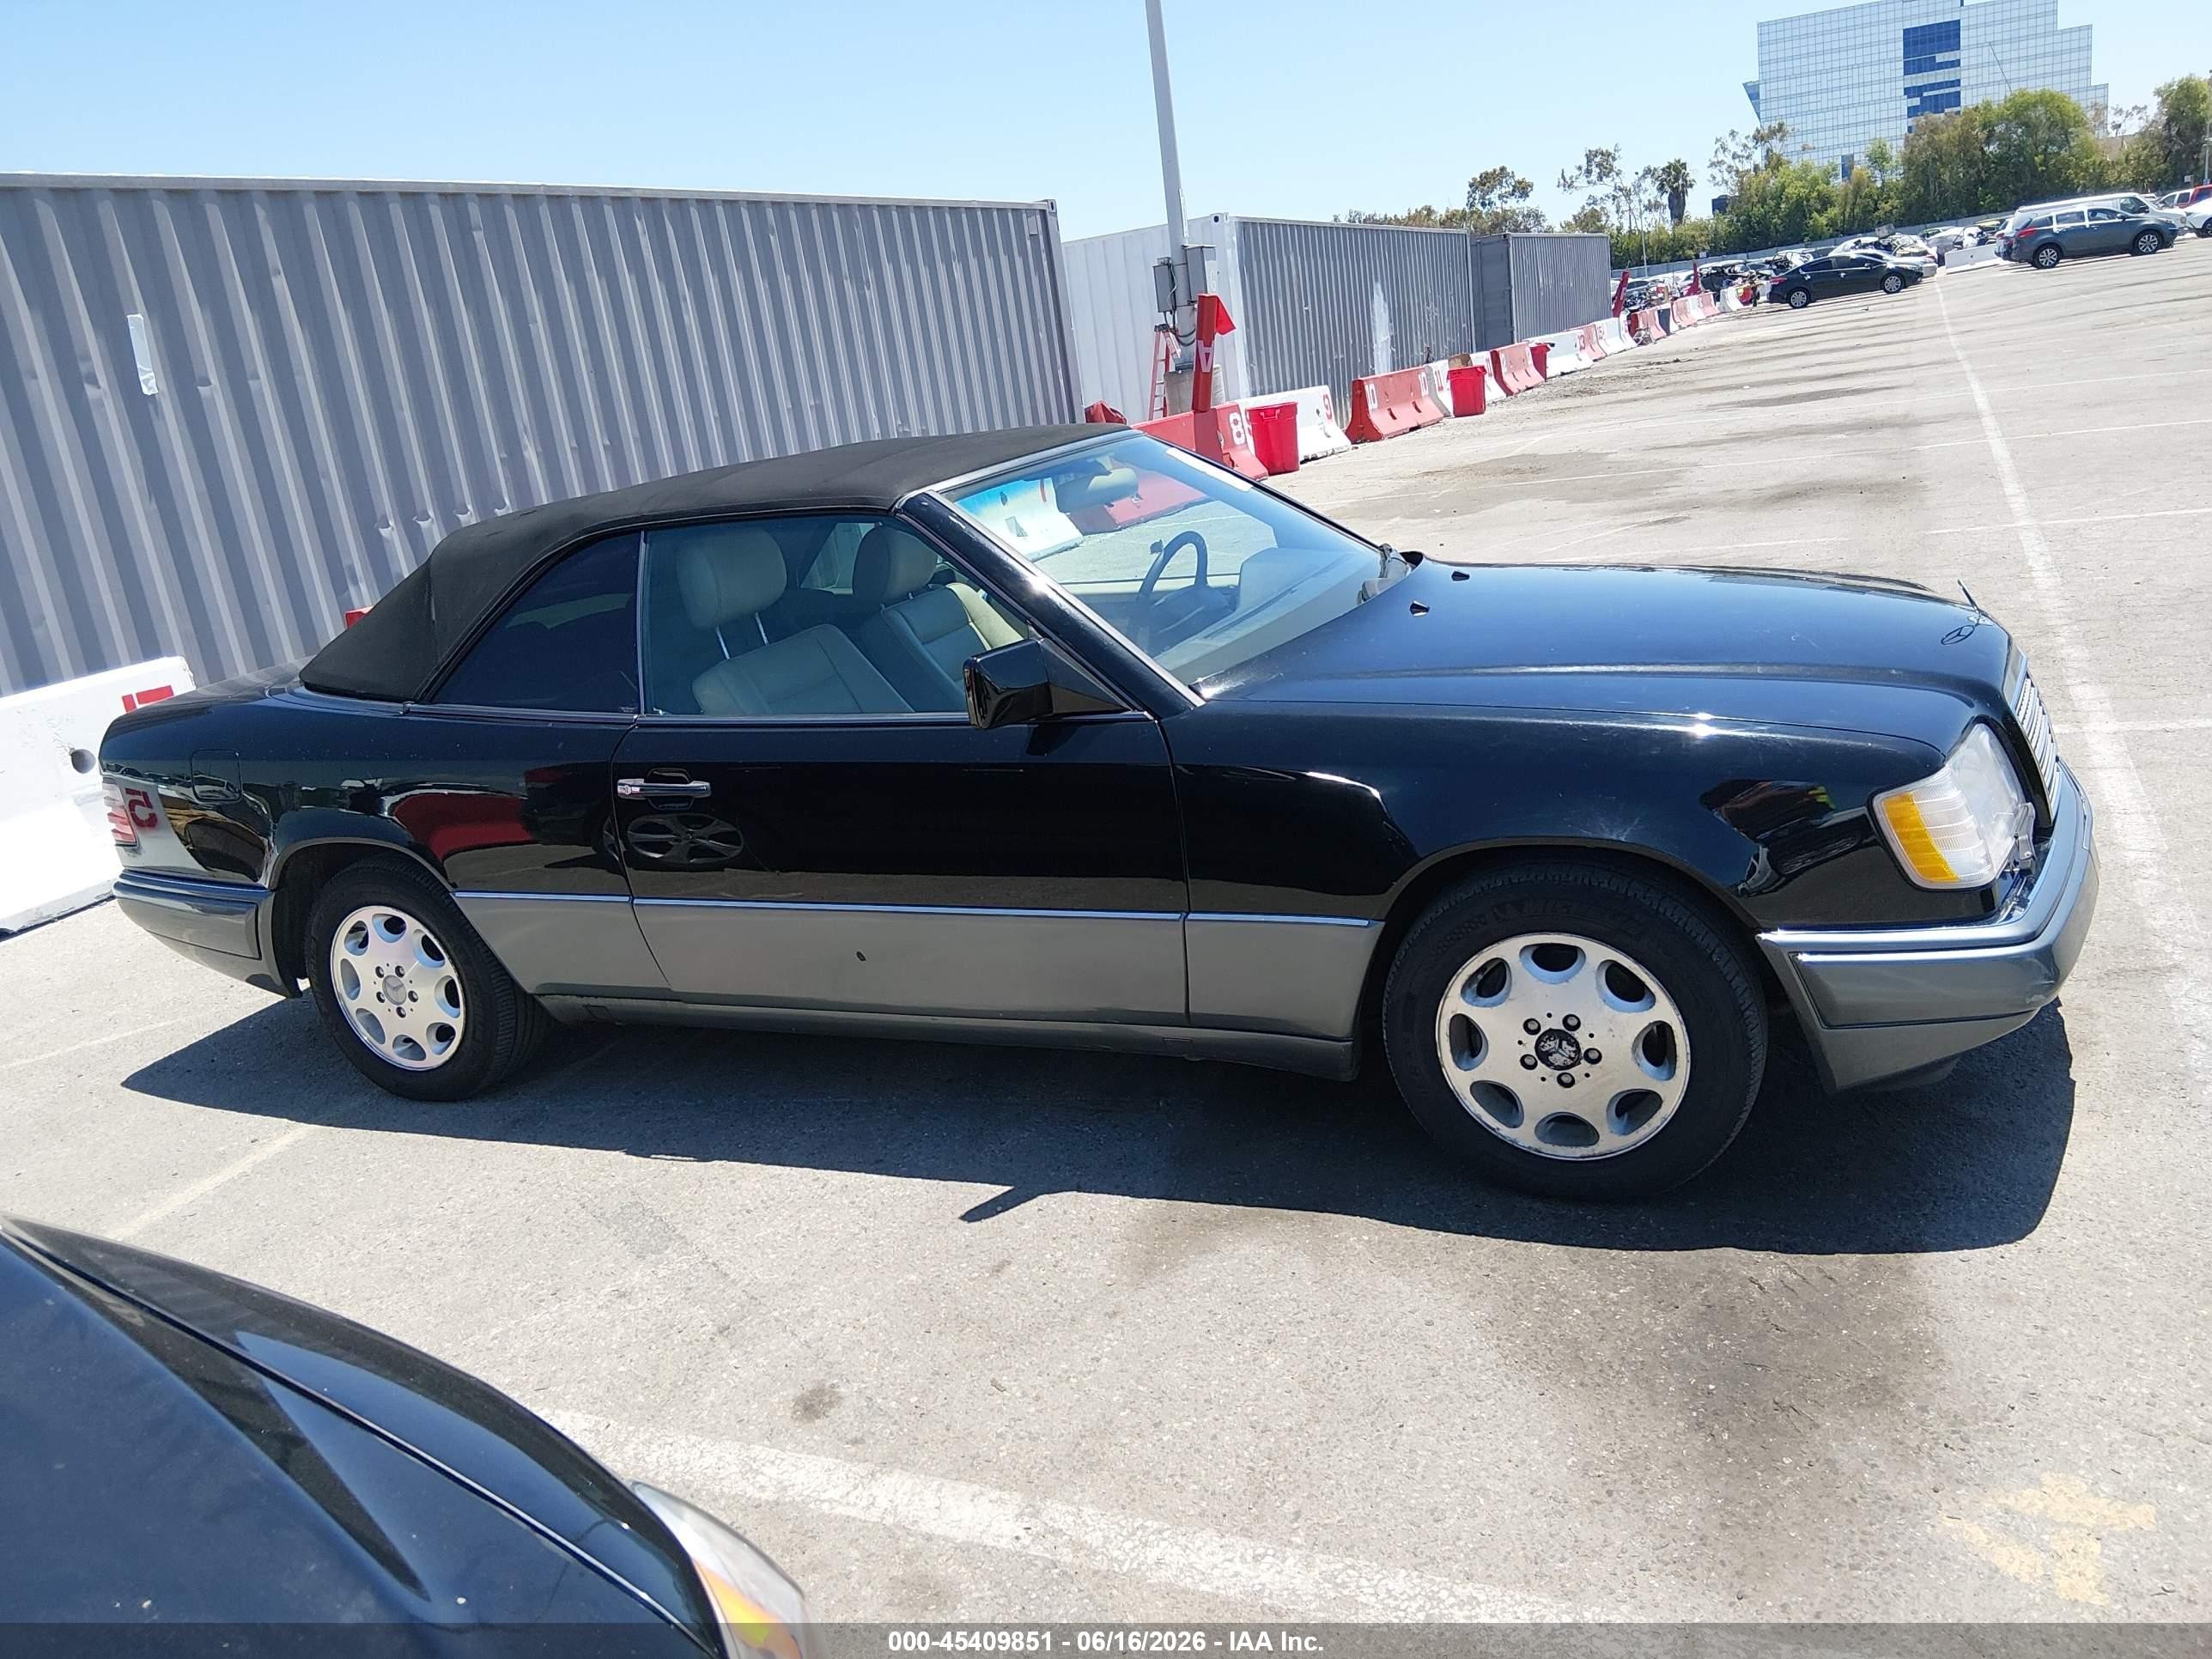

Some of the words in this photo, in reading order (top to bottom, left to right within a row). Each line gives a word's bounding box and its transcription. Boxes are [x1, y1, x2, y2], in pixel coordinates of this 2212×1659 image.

[1365, 383, 1379, 410] 10
[1419, 371, 1430, 397] 10
[1322, 393, 1333, 420] 9
[1229, 411, 1246, 445] 8
